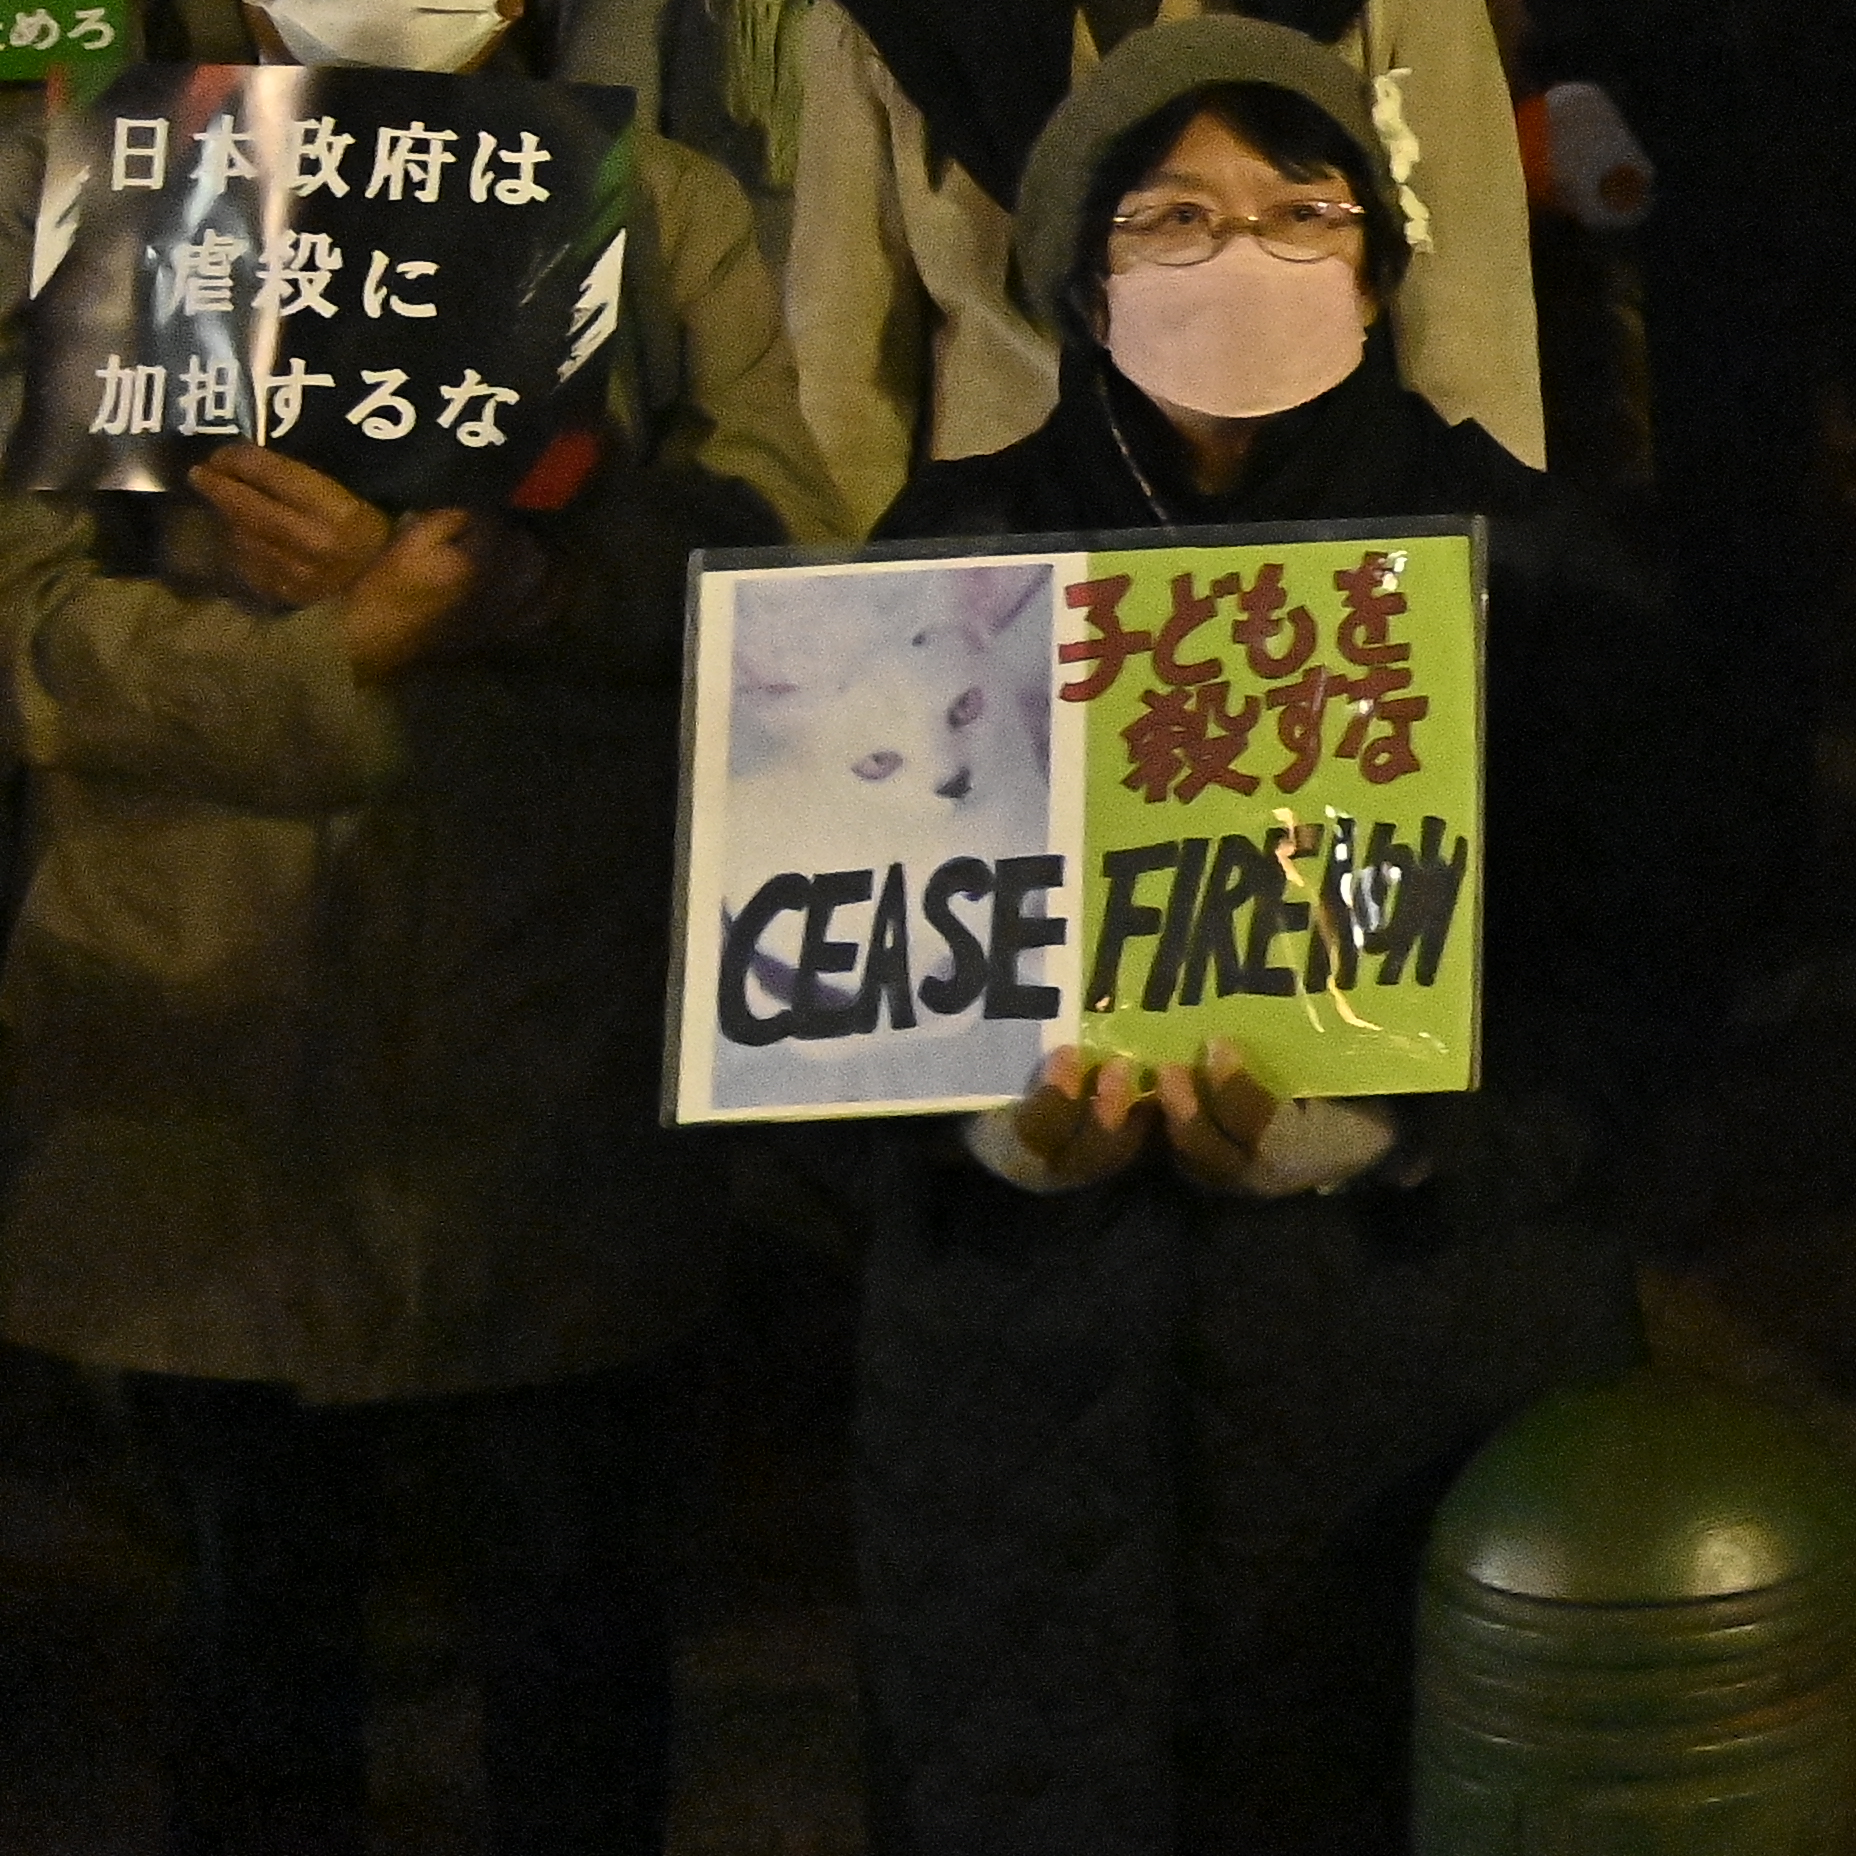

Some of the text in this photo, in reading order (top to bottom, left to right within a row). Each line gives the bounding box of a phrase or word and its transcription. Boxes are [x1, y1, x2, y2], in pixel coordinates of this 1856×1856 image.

[110, 112, 552, 206] 日本政府は
[168, 228, 439, 320] 虐殺に
[88, 353, 522, 449] 加担するな
[1058, 551, 1411, 703] 子どもを
[1119, 666, 1430, 804] 殺すな
[717, 852, 1068, 1047] CEASE
[1084, 824, 1327, 1013] FIRE
